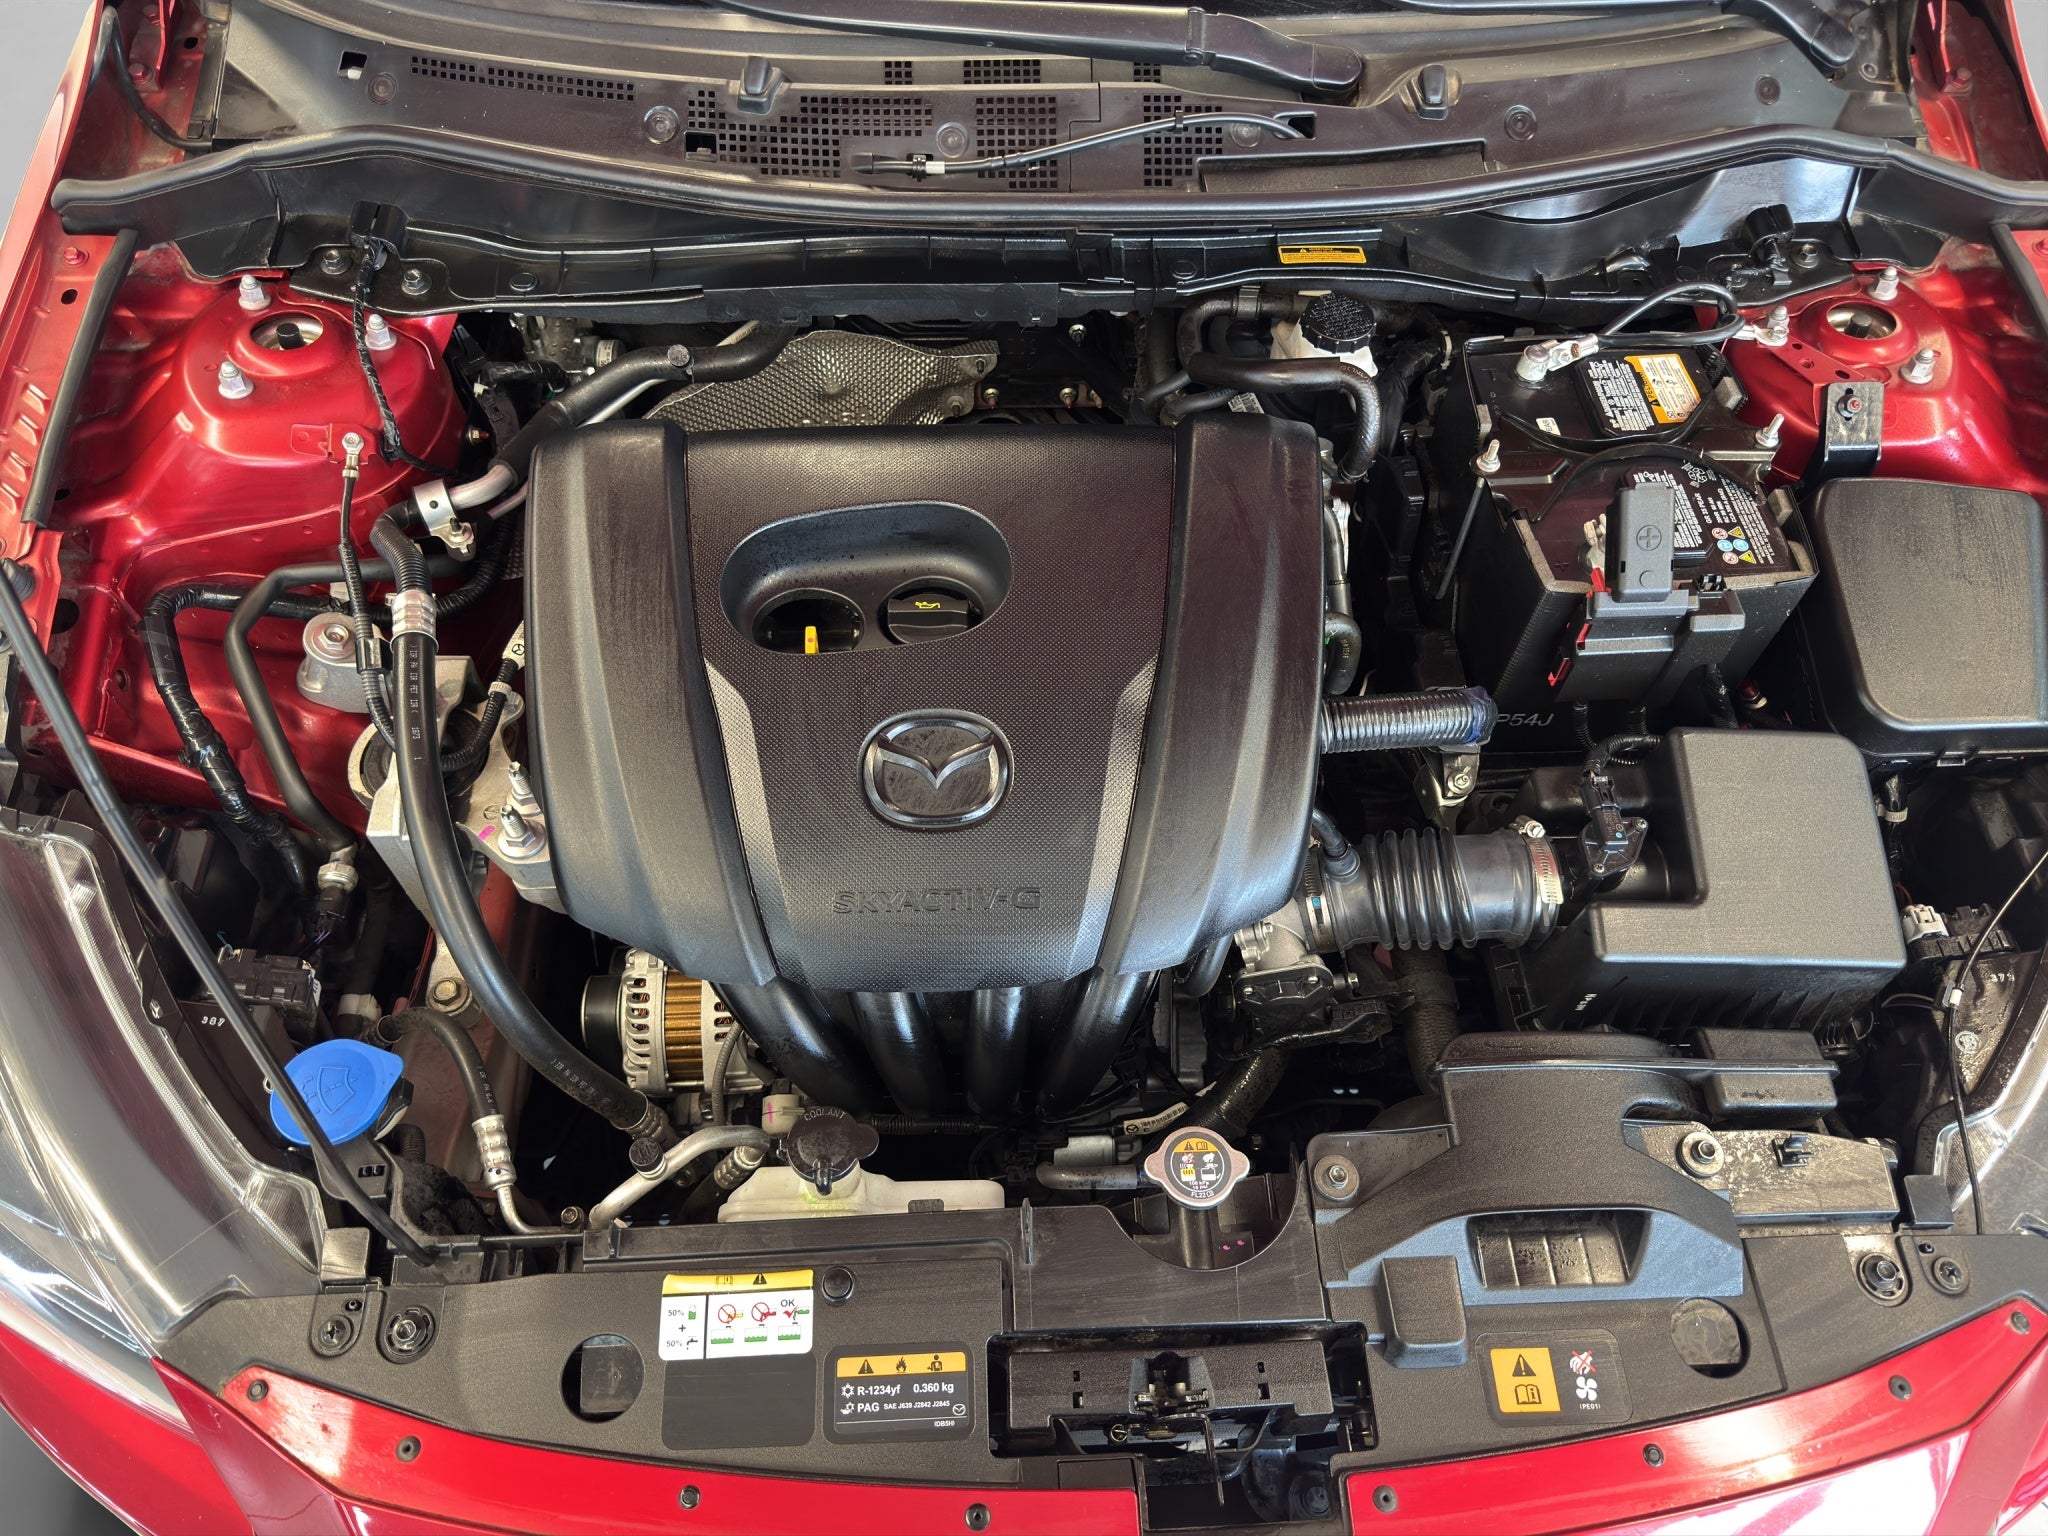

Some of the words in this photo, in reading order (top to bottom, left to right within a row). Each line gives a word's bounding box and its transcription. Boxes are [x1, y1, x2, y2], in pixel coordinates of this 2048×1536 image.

[833, 888, 1041, 914] SKYACTIV-G
[804, 1108, 847, 1121] COOLANT
[780, 1299, 795, 1307] OK
[668, 1309, 685, 1317] 50%
[666, 1339, 683, 1347] 50%
[857, 1384, 901, 1396] R-1234yf
[913, 1383, 939, 1393] 0.360
[941, 1382, 954, 1393] kg
[857, 1402, 880, 1412] PAG
